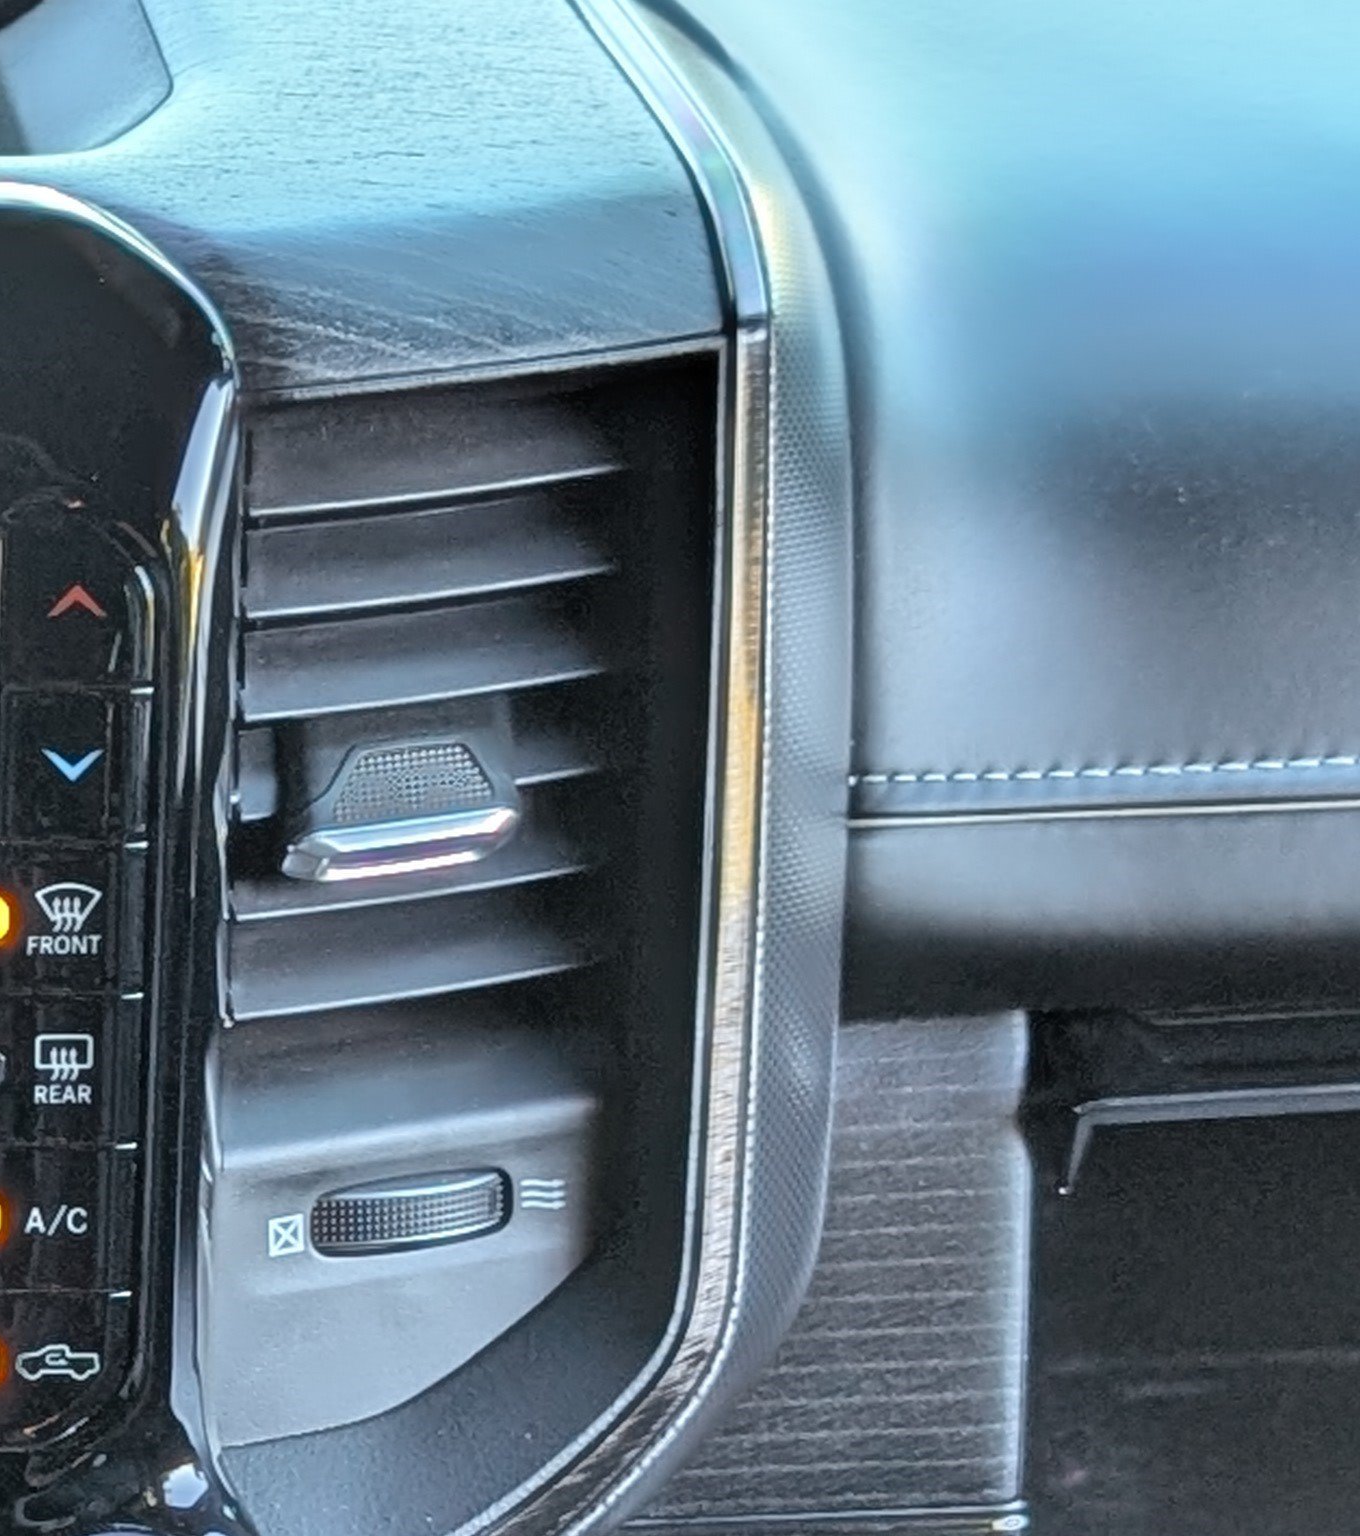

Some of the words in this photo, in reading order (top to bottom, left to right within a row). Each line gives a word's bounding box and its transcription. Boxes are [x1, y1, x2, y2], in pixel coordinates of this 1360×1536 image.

[26, 935, 102, 956] FRONT
[34, 1086, 91, 1104] REAR
[24, 1206, 88, 1235] A/C
